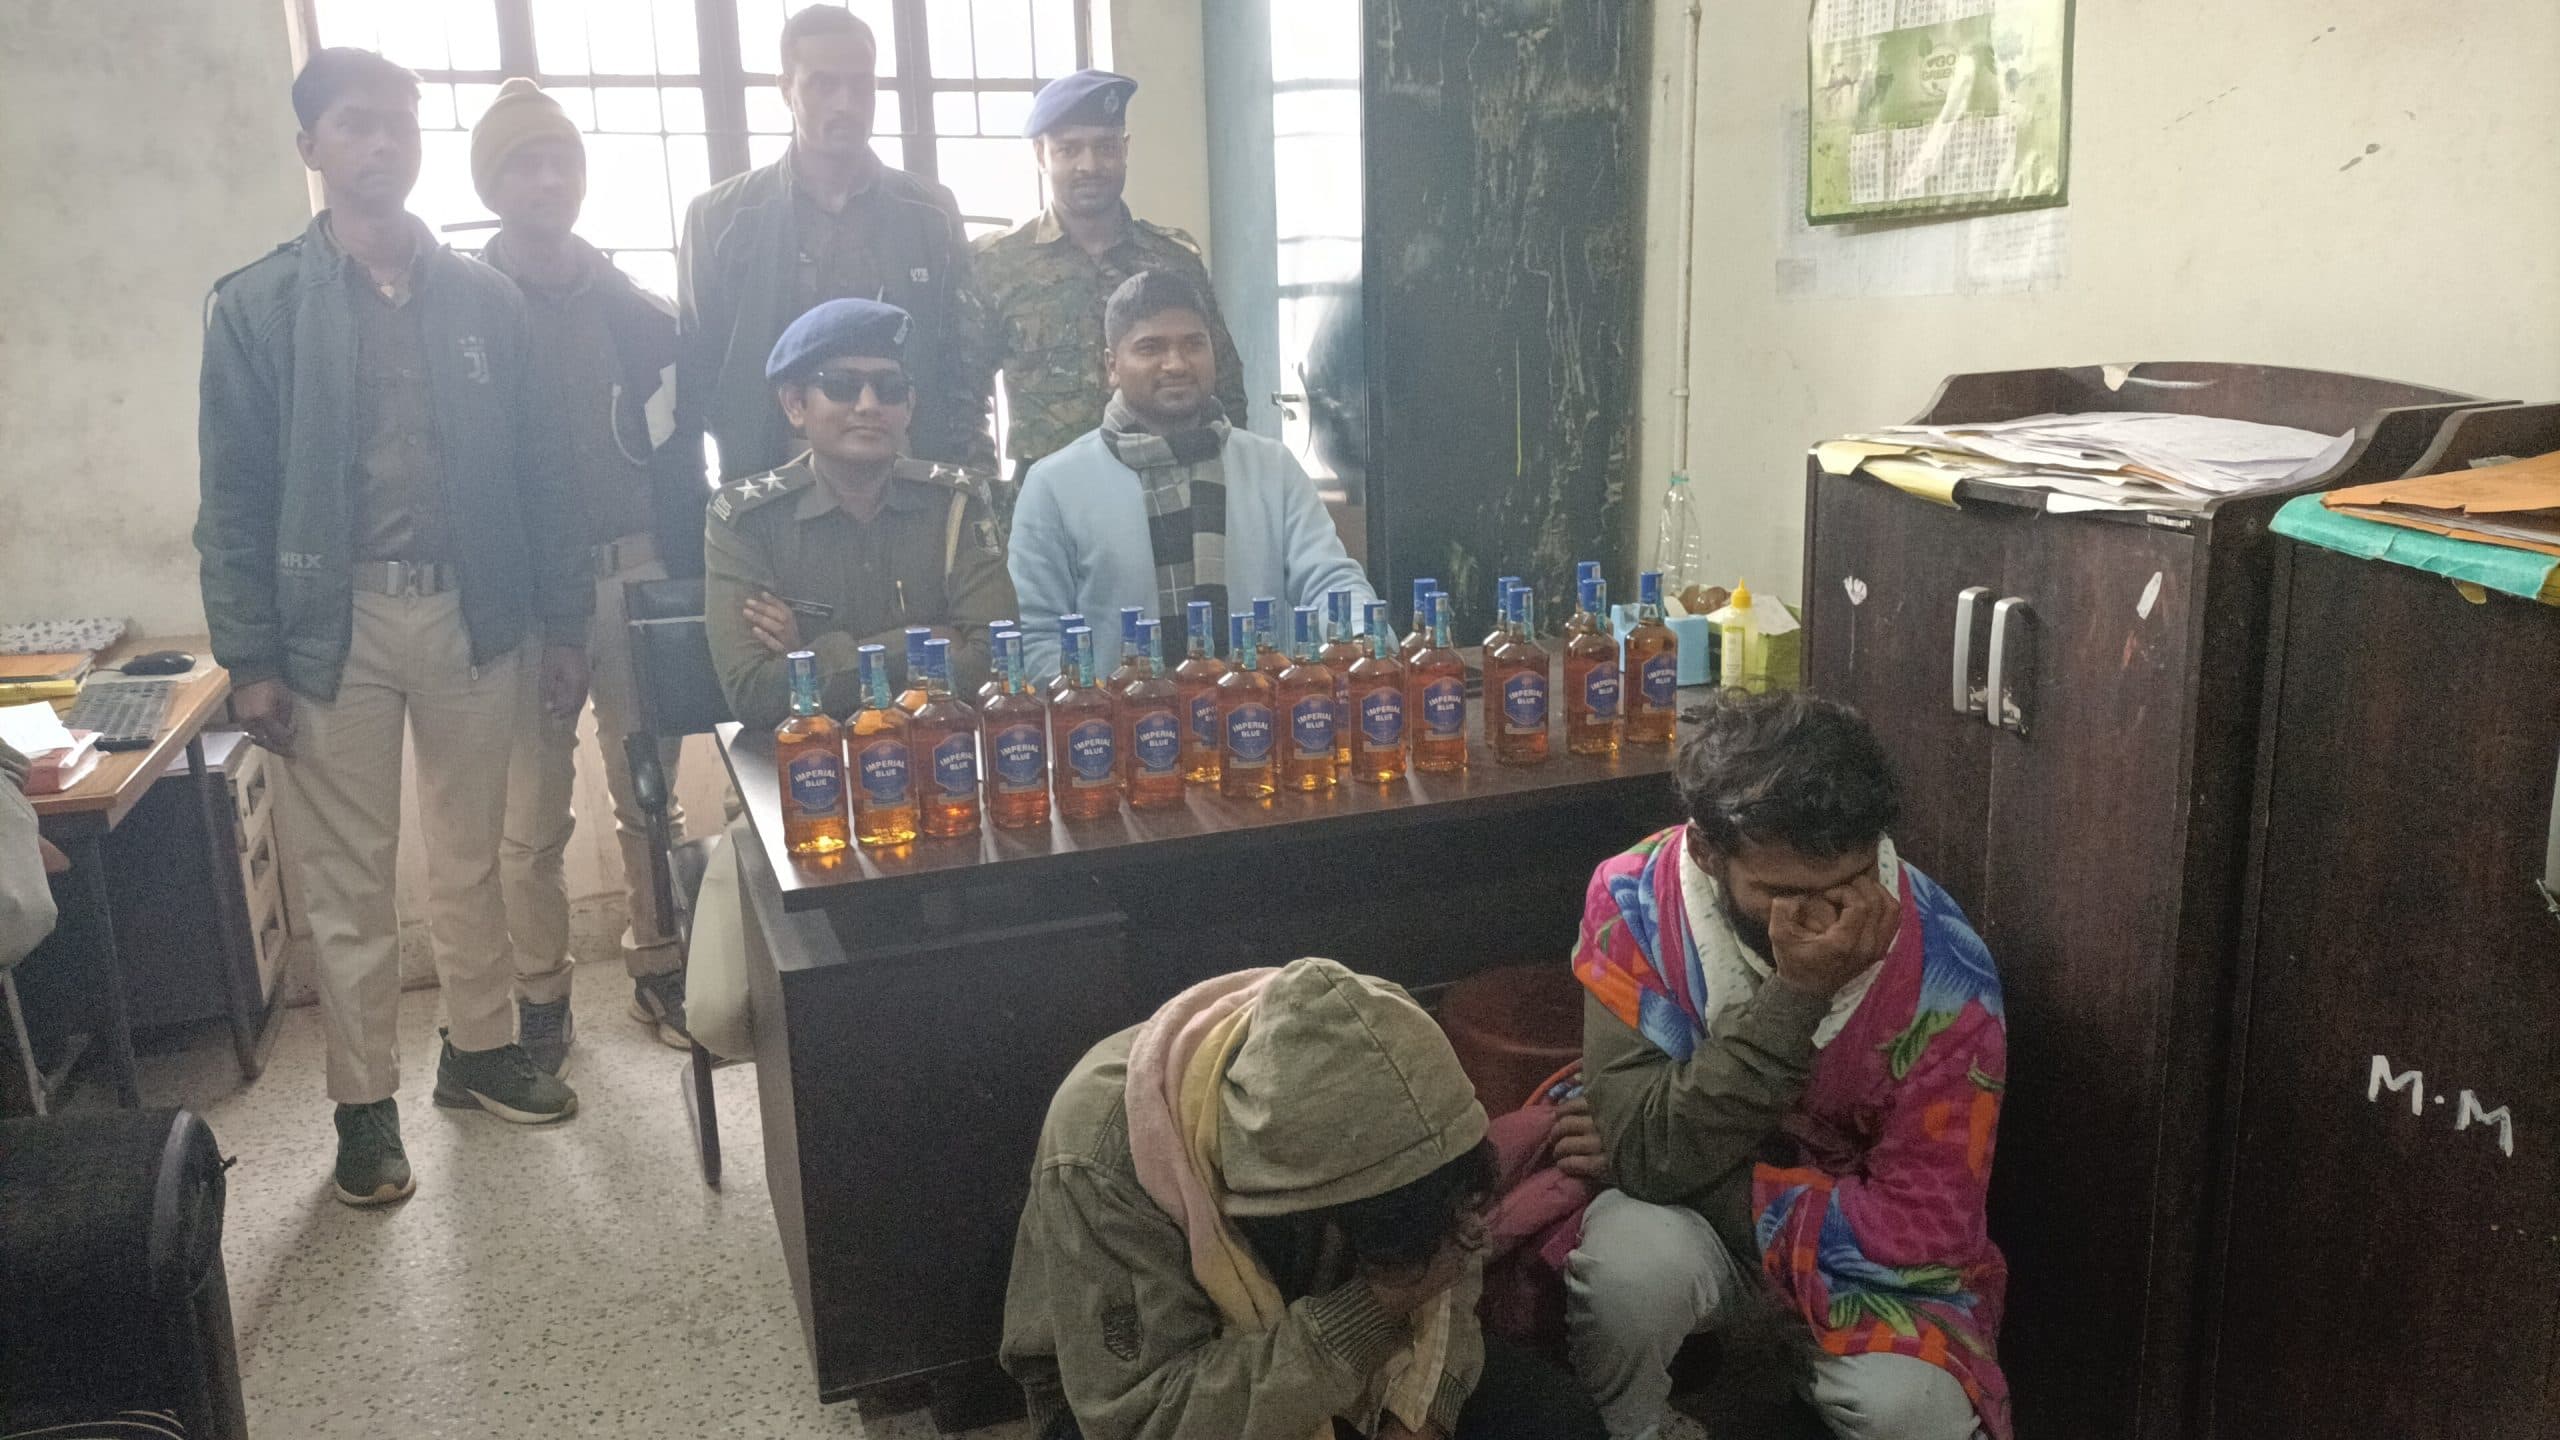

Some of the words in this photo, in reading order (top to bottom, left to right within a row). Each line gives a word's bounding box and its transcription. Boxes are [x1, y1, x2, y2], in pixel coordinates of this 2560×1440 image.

[1508, 688, 1543, 700] IMPERIAL
[1428, 695, 1461, 706] IMPERIAL
[1517, 697, 1536, 705] BLUE
[1366, 705, 1400, 717] IMPERIAL
[1297, 712, 1332, 723] IMPERIAL
[1375, 713, 1393, 721] BLUE
[1232, 721, 1269, 732] IMPERIAL
[1306, 720, 1325, 729] BLUE
[1140, 730, 1176, 741] IMPERIAL
[1073, 738, 1111, 751] IMPERIAL
[1149, 739, 1169, 747] BLUE
[1000, 743, 1039, 756] IMPERIAL
[1084, 747, 1104, 755] BLUE
[1010, 752, 1031, 760] BLUE
[865, 760, 905, 773] IMPERIAL
[795, 769, 836, 783] IMPERIAL
[875, 768, 897, 777] BLUE
[805, 778, 828, 787] BLUE
